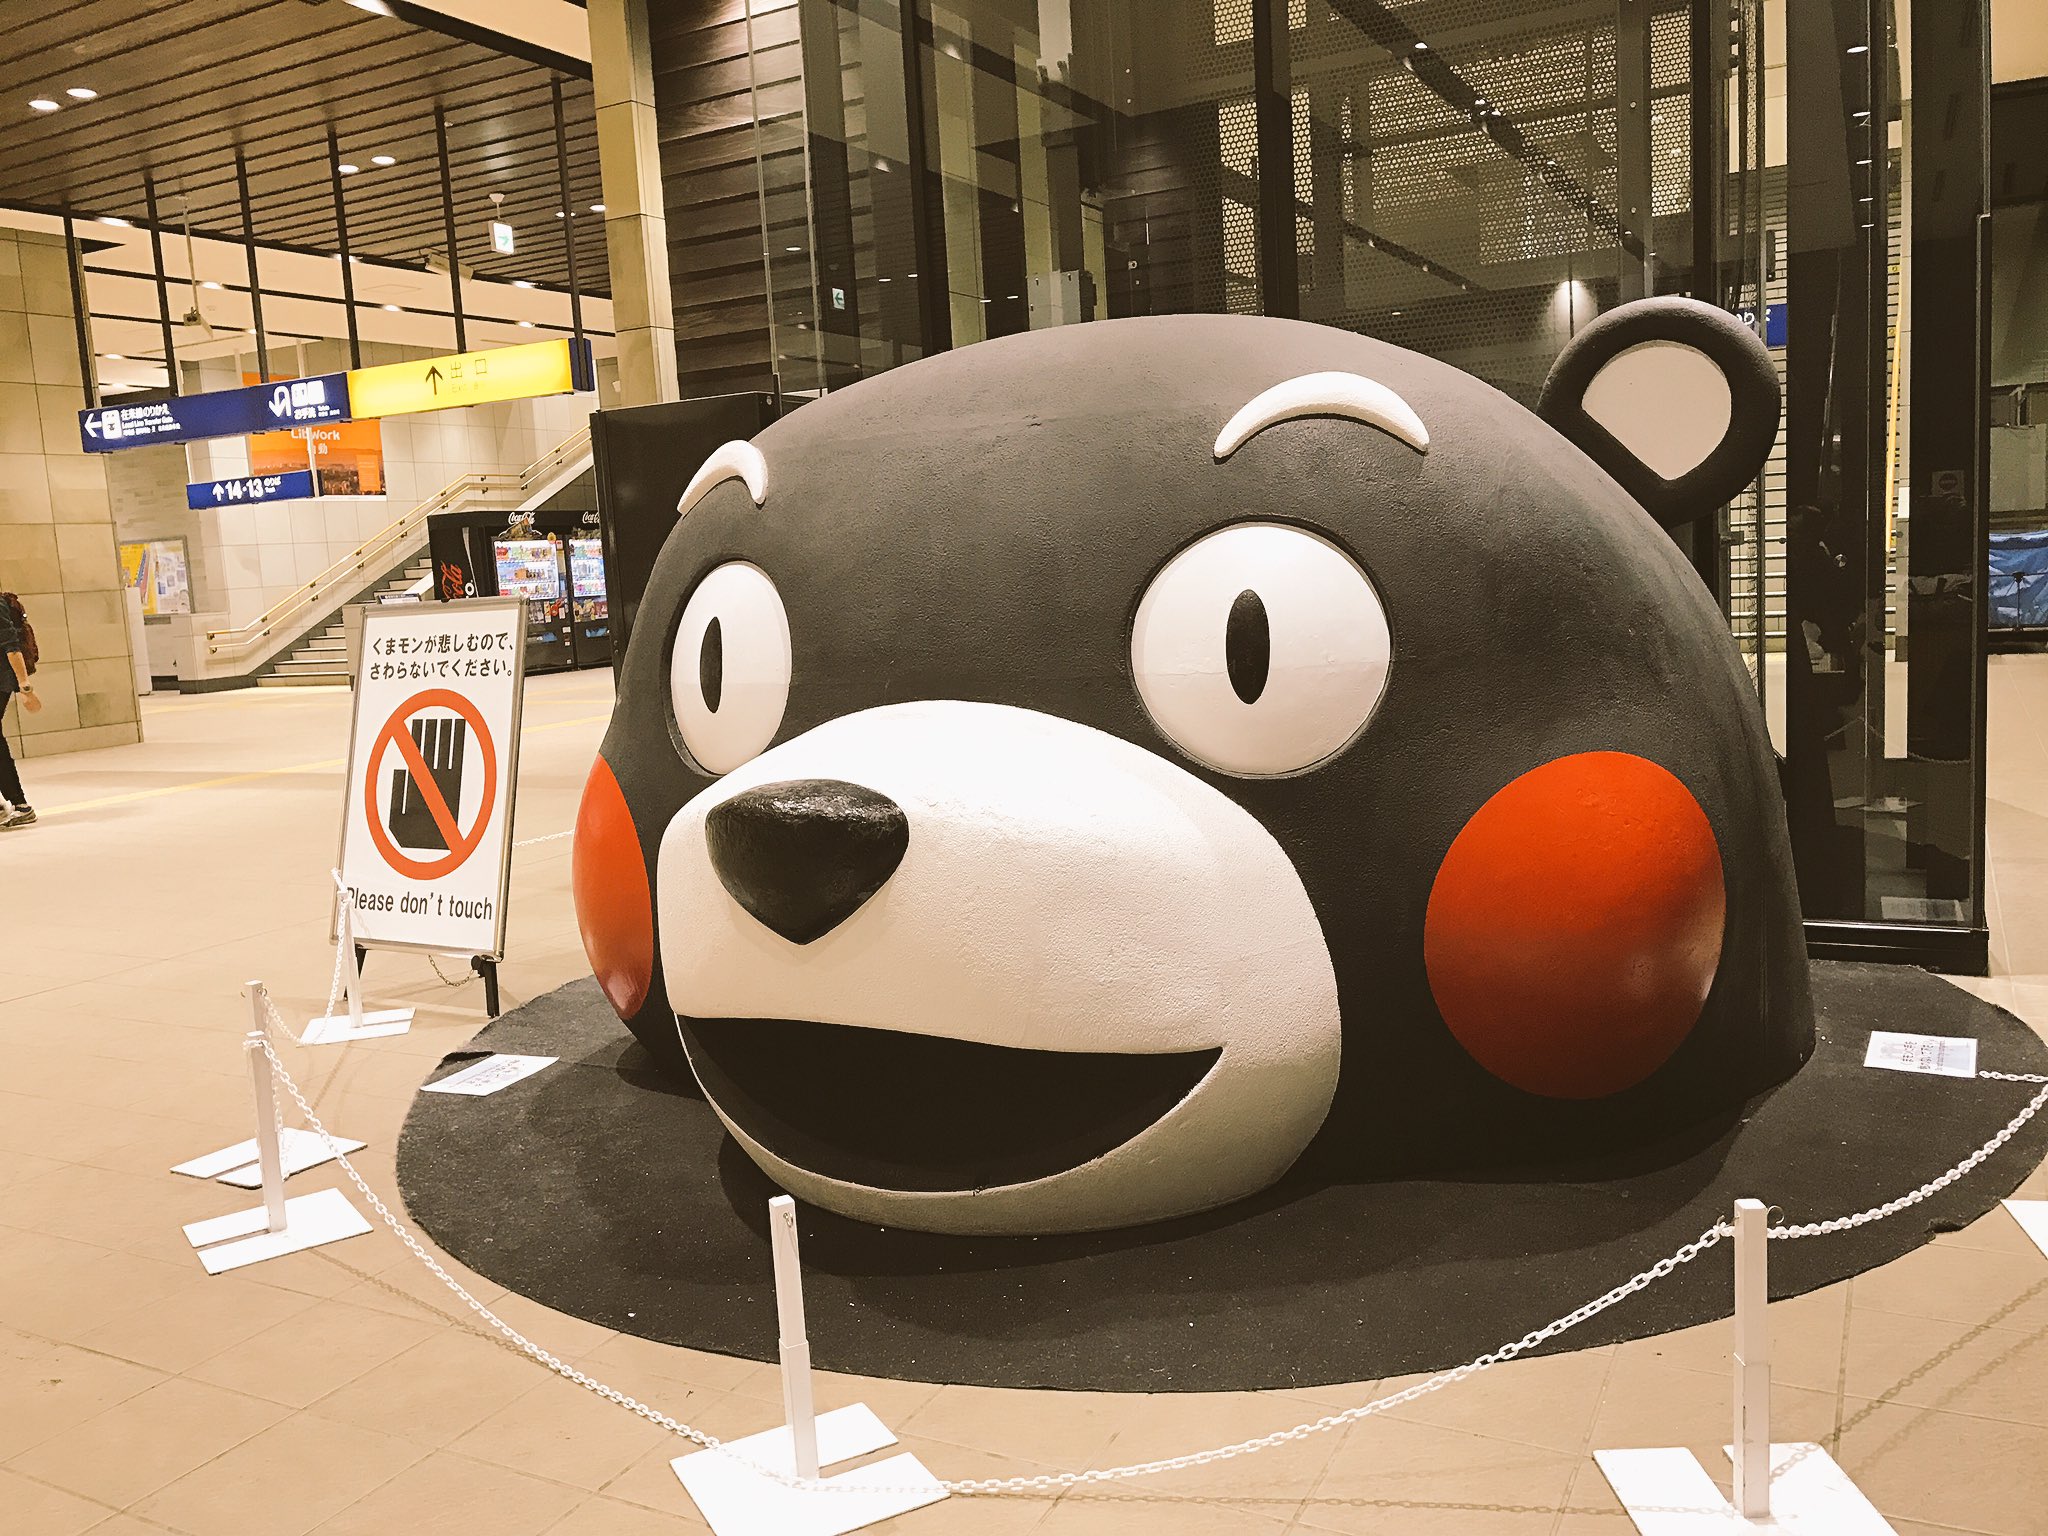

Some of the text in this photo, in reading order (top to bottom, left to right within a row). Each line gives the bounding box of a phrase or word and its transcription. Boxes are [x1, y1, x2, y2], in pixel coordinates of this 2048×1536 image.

[372, 632, 514, 656] くまモンが悲しむので、
[370, 658, 513, 681] さわらないでください。
[450, 895, 493, 920] touch
